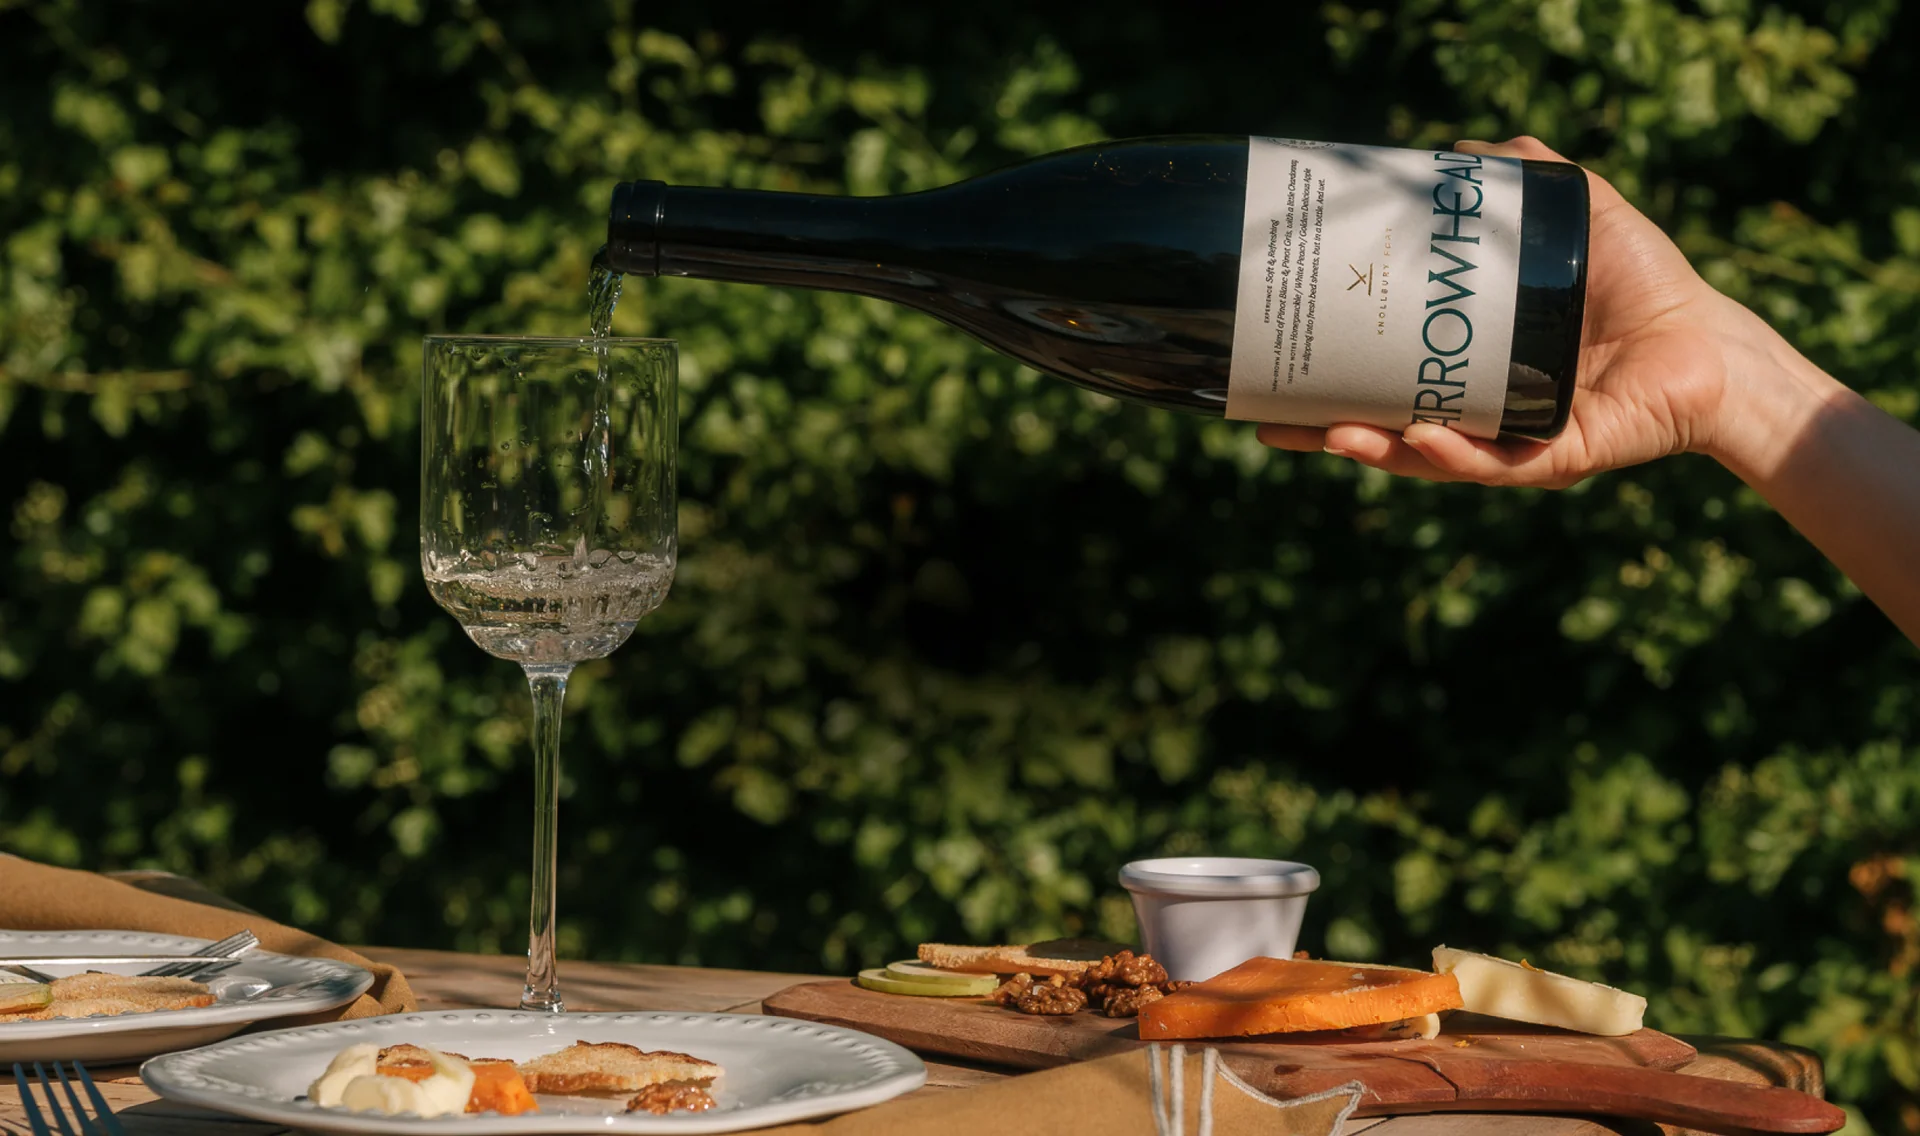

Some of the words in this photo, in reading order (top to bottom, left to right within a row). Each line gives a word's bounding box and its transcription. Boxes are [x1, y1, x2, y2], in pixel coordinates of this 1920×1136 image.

[1268, 219, 1280, 258] Refreshing
[1266, 266, 1275, 284] Soft
[1376, 265, 1389, 336] KNOLLBURY
[1411, 153, 1482, 425] ARROWHEAD
